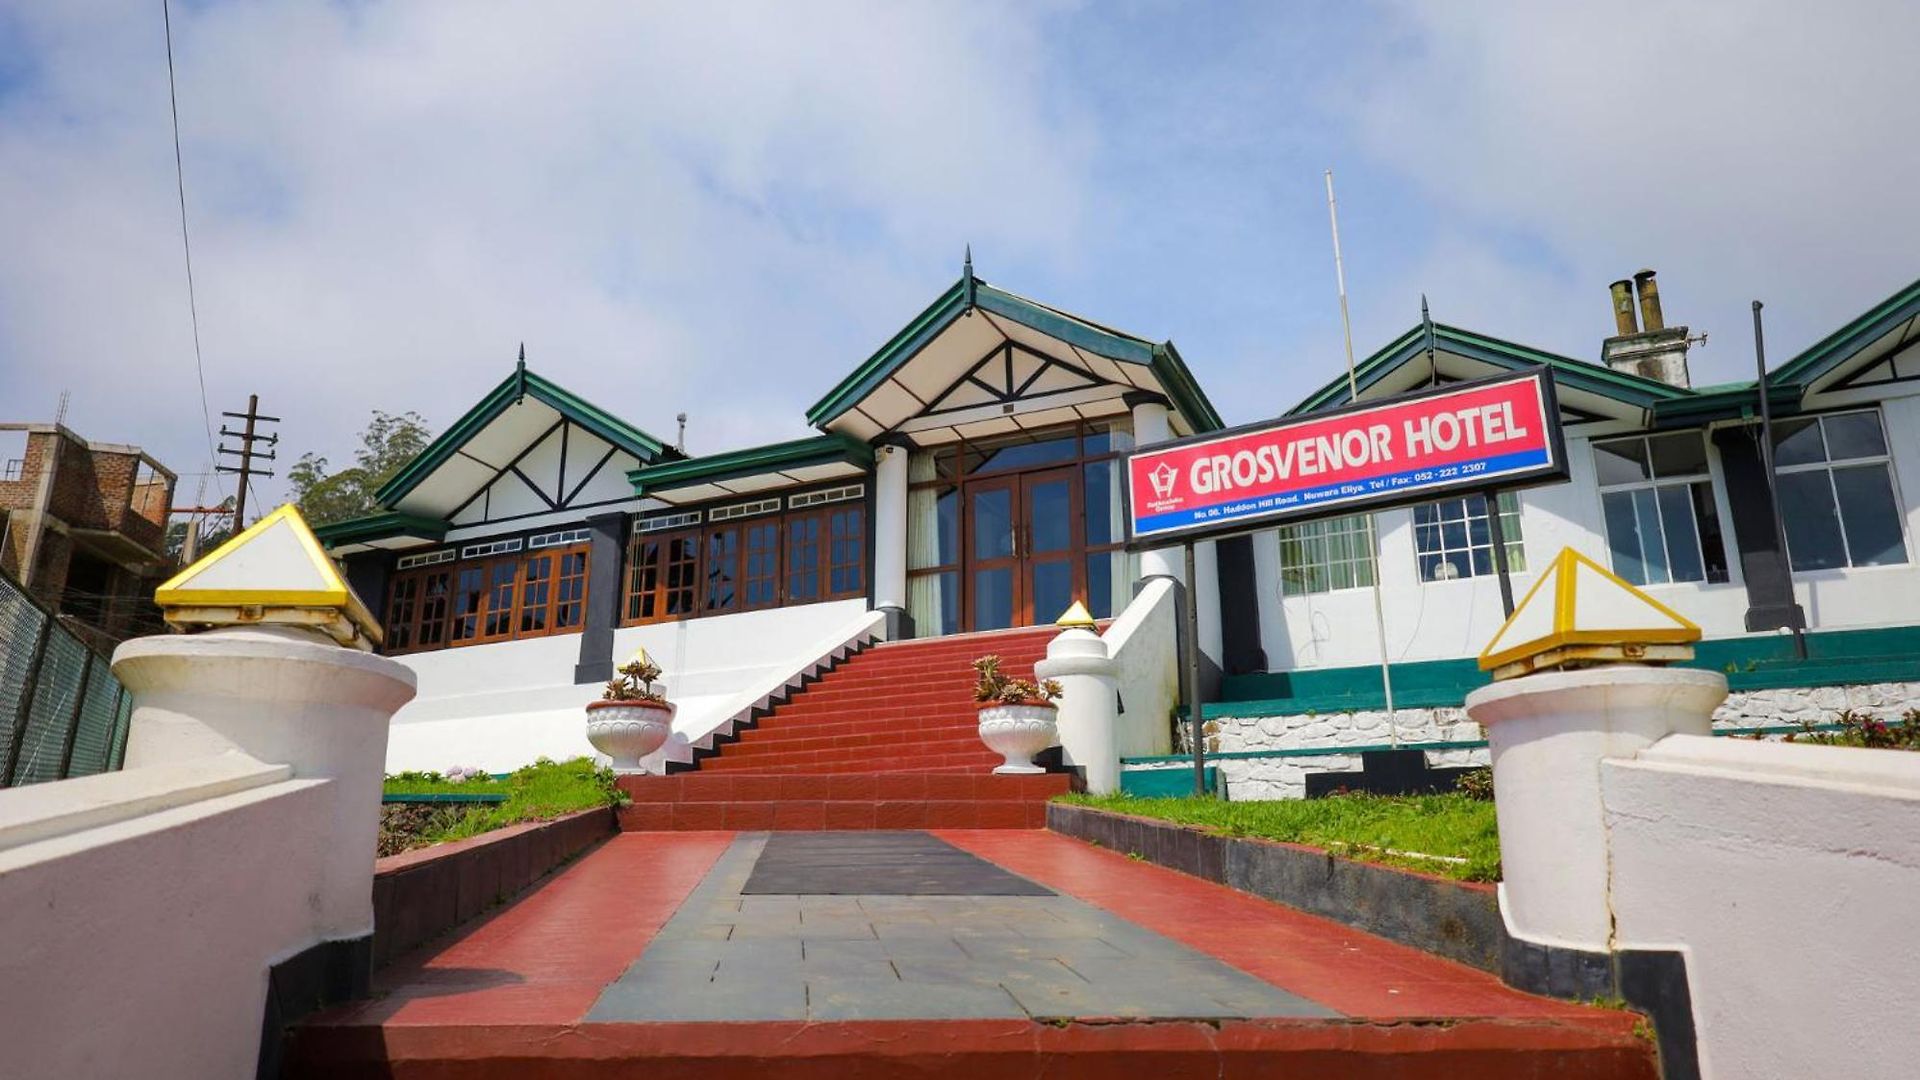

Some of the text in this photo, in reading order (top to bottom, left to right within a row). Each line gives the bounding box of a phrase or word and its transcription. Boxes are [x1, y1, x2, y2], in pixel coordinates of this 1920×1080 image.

[1190, 401, 1526, 495] GROSVENOR HOTEL
[1259, 499, 1274, 509] Hill
[1303, 488, 1339, 501] Nuwara
[1462, 462, 1487, 474] 2307
